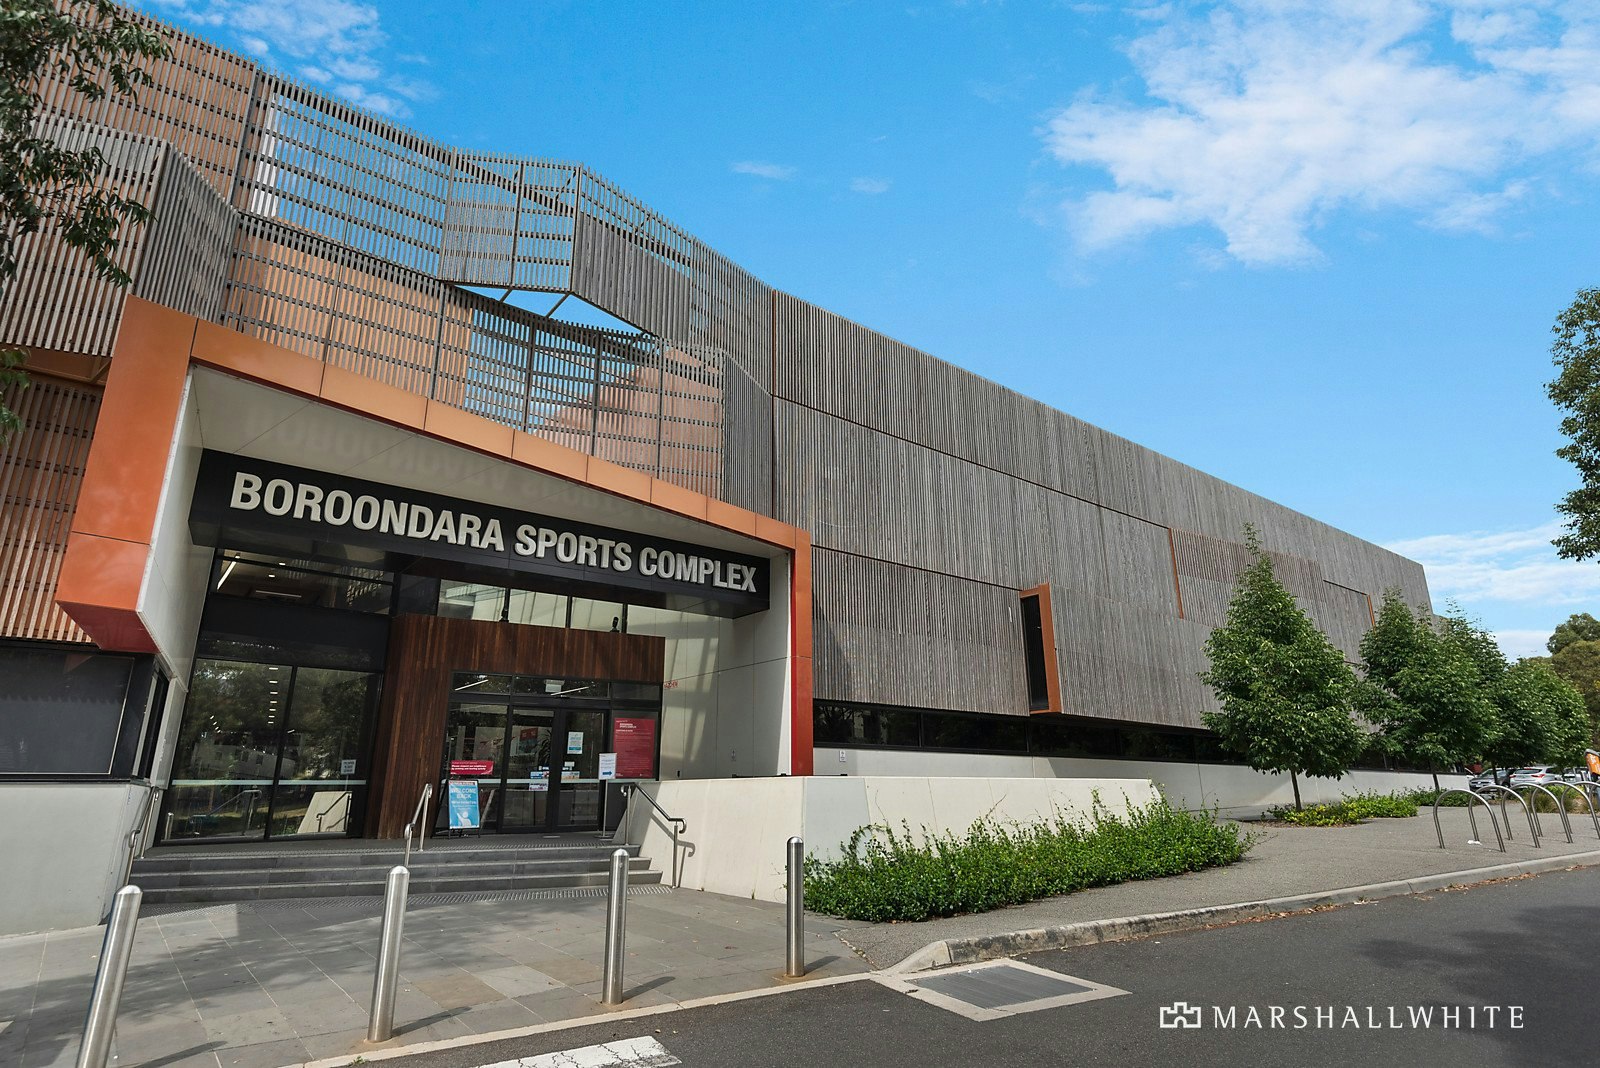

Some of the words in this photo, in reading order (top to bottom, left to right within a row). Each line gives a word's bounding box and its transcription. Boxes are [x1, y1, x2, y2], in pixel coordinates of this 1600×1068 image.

[229, 471, 505, 552] BOROONDARA
[514, 524, 632, 572] SPORTS
[639, 547, 757, 594] COMPLEX
